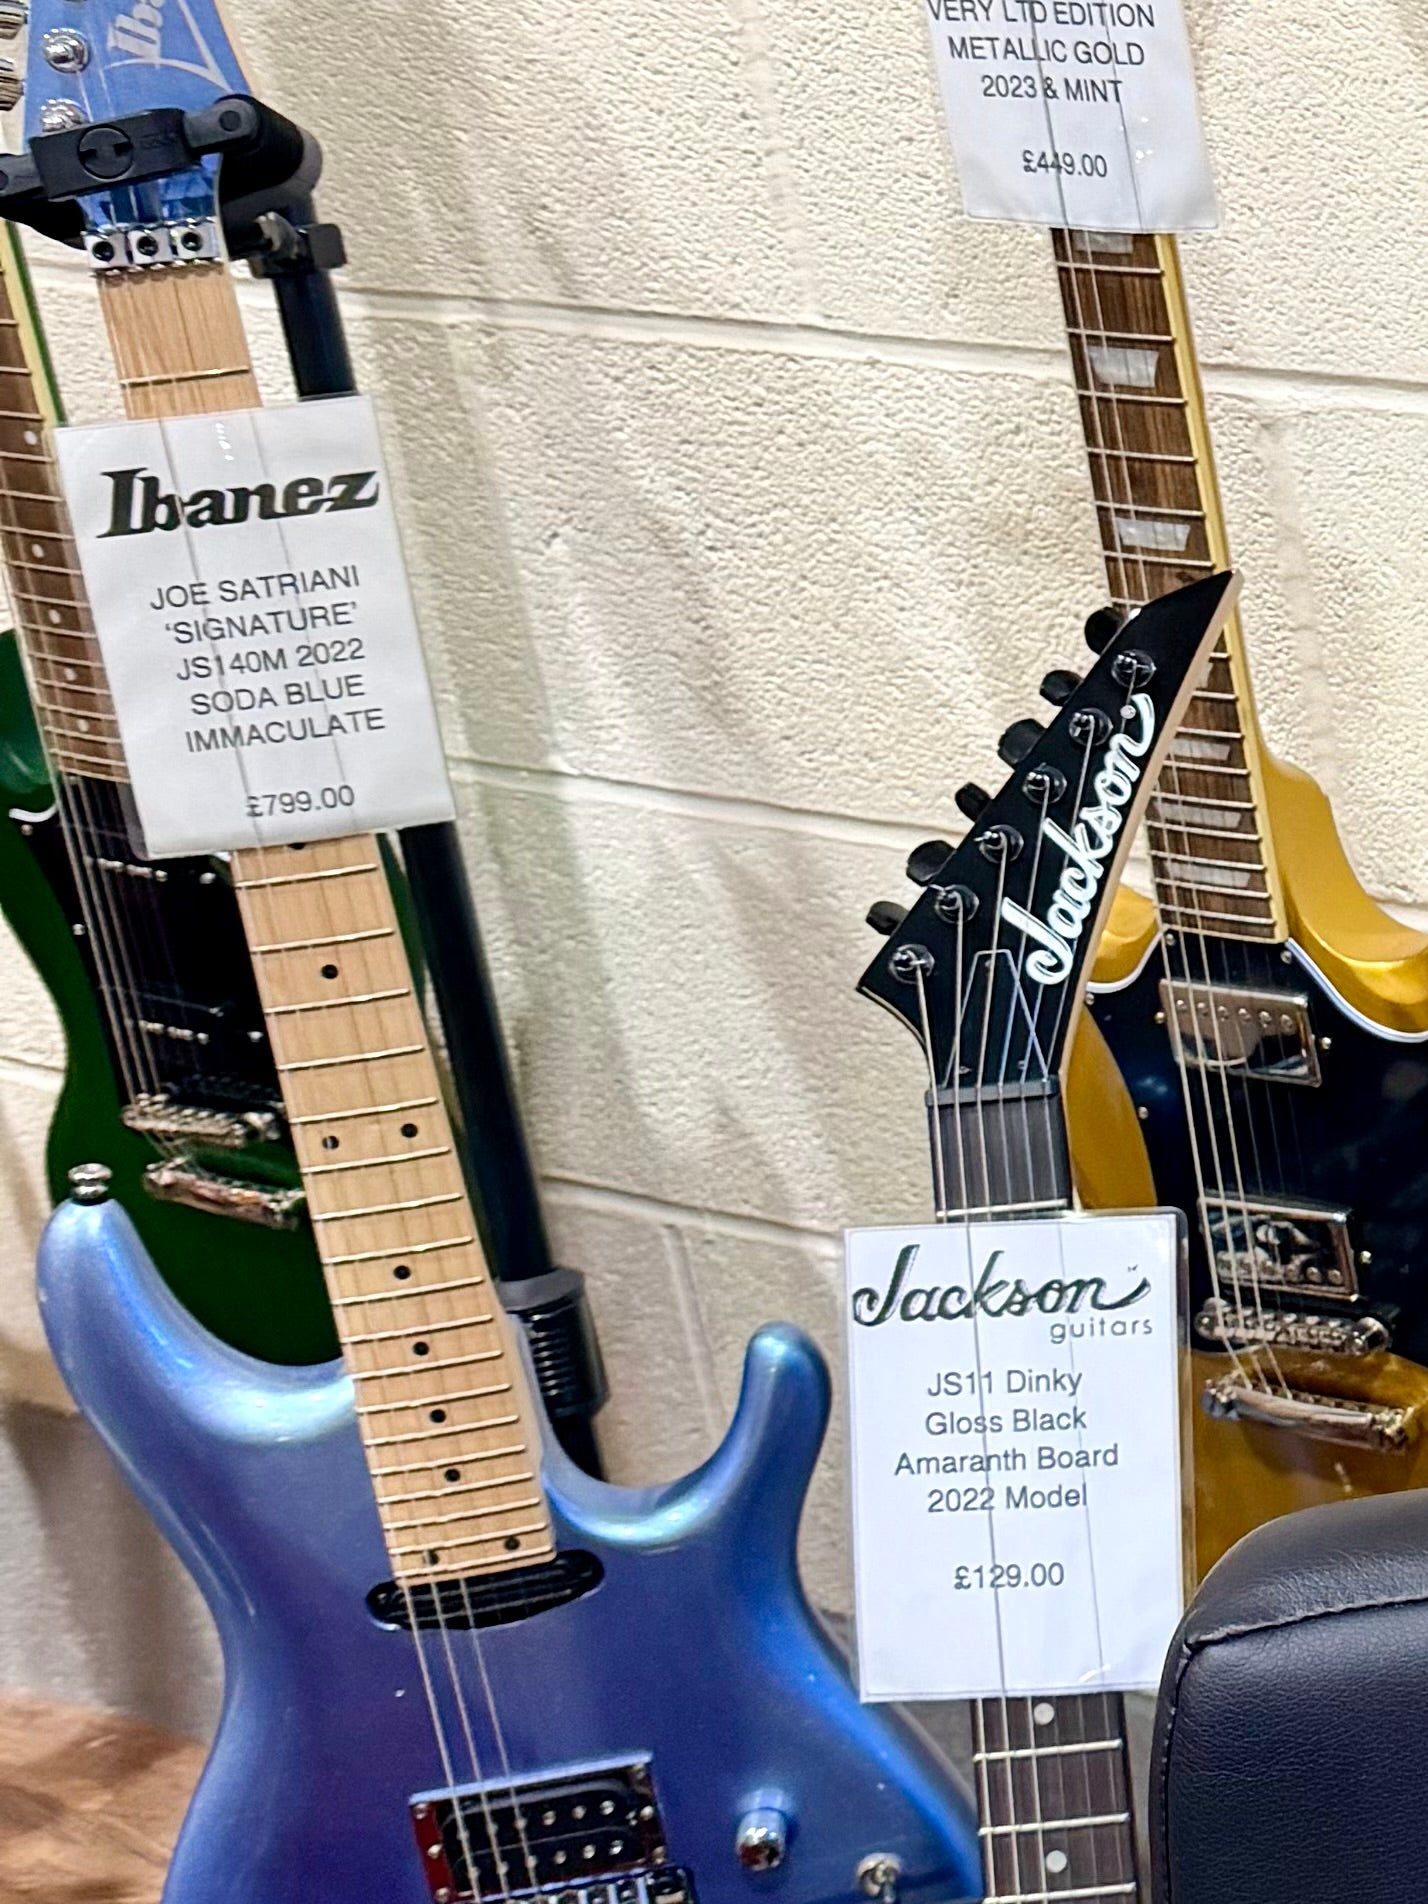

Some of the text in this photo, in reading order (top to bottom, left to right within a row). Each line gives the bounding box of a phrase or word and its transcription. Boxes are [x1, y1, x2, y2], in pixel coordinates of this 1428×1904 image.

[1003, 0, 1048, 25] LTD
[1055, 3, 1155, 29] EDITION
[948, 37, 1145, 66] METALLIC GOLD
[981, 75, 1123, 103] 2023 & MINT
[1022, 149, 1108, 178] £449.00
[96, 466, 380, 539] Ibanez
[149, 564, 360, 611] JOE SATRIANI
[176, 638, 366, 682] JS140M 2022
[190, 675, 366, 716] SODA BLUE
[185, 707, 386, 753] IMMACULATE
[245, 784, 355, 818] £799.00
[1001, 692, 1157, 986] Jackson
[852, 1243, 1153, 1327] Jackson
[1049, 1315, 1154, 1344] guitars
[927, 1368, 1084, 1398] JS11 Dinky
[924, 1405, 1088, 1436] Gloss Black
[894, 1443, 1120, 1476] Amaranth Board
[927, 1483, 1088, 1513] 2022 Model
[953, 1561, 1066, 1591] £129.00
